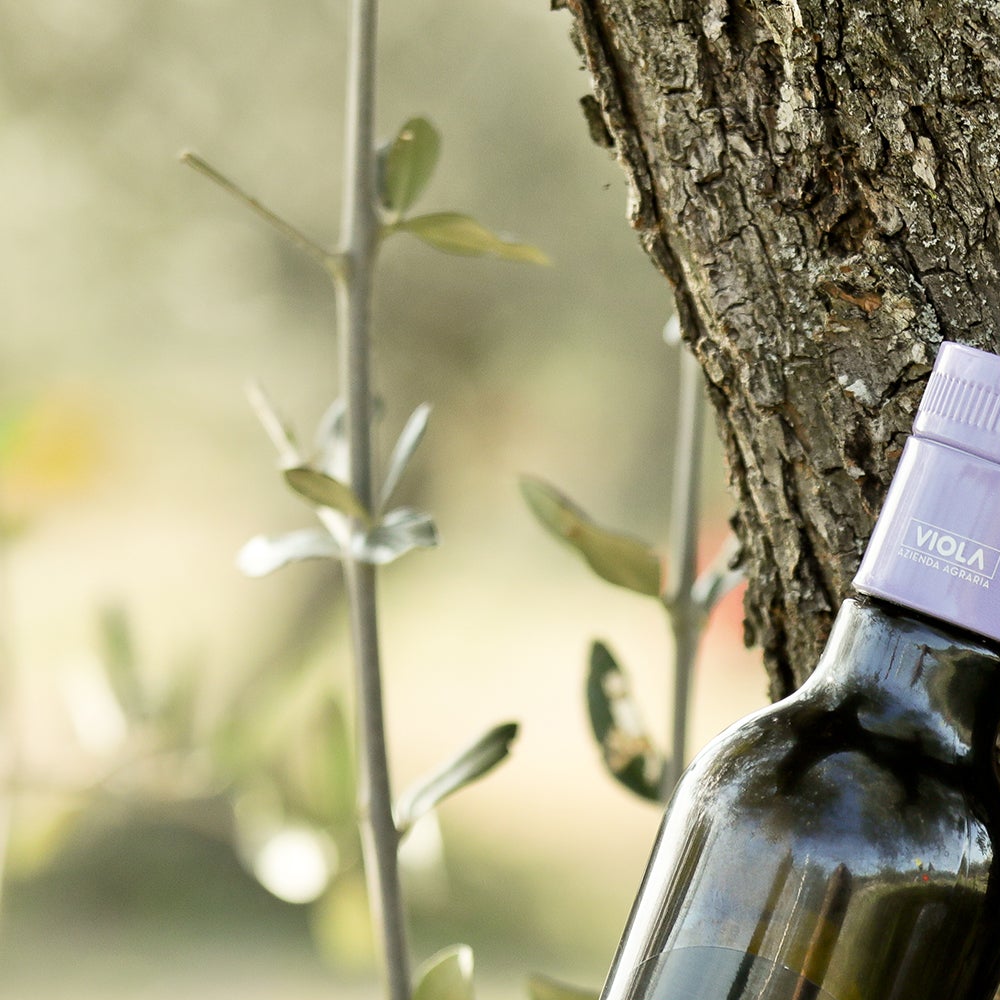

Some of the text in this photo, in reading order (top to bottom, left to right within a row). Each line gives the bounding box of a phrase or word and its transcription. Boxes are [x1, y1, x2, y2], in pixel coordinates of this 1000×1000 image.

[897, 548, 990, 588] AZIENDA AGRARIA
[917, 525, 984, 570] VIOLA
